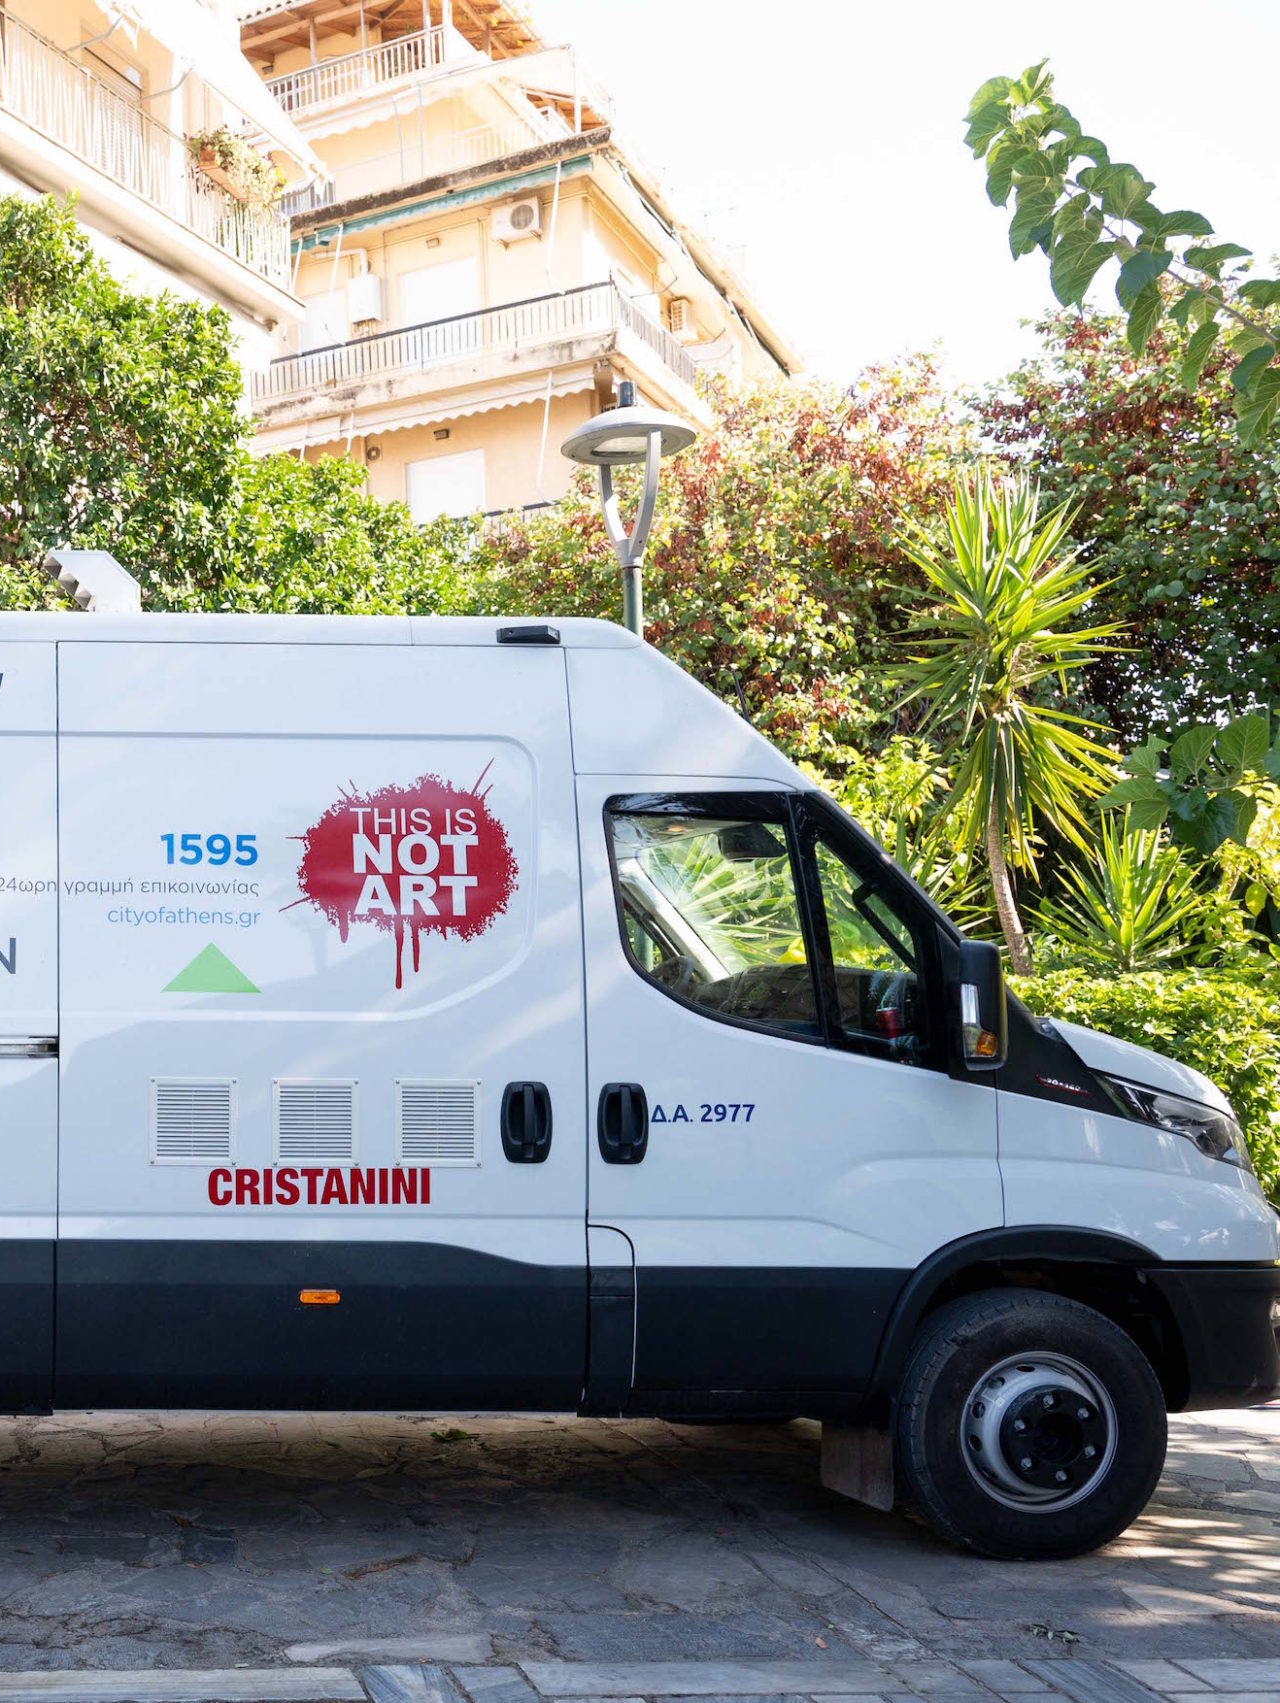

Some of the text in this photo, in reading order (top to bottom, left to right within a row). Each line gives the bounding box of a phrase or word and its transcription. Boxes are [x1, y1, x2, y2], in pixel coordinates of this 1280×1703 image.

[350, 807, 478, 835] THIS IS
[160, 833, 259, 867] 1595
[352, 833, 479, 875] NOT
[63, 877, 134, 896] γραμμή
[140, 877, 259, 898] επικοινωνίας
[353, 874, 478, 916] ART
[107, 905, 261, 928] cityofathens.gr
[699, 1103, 756, 1122] 2977
[208, 1167, 431, 1206] CRISTANINI
